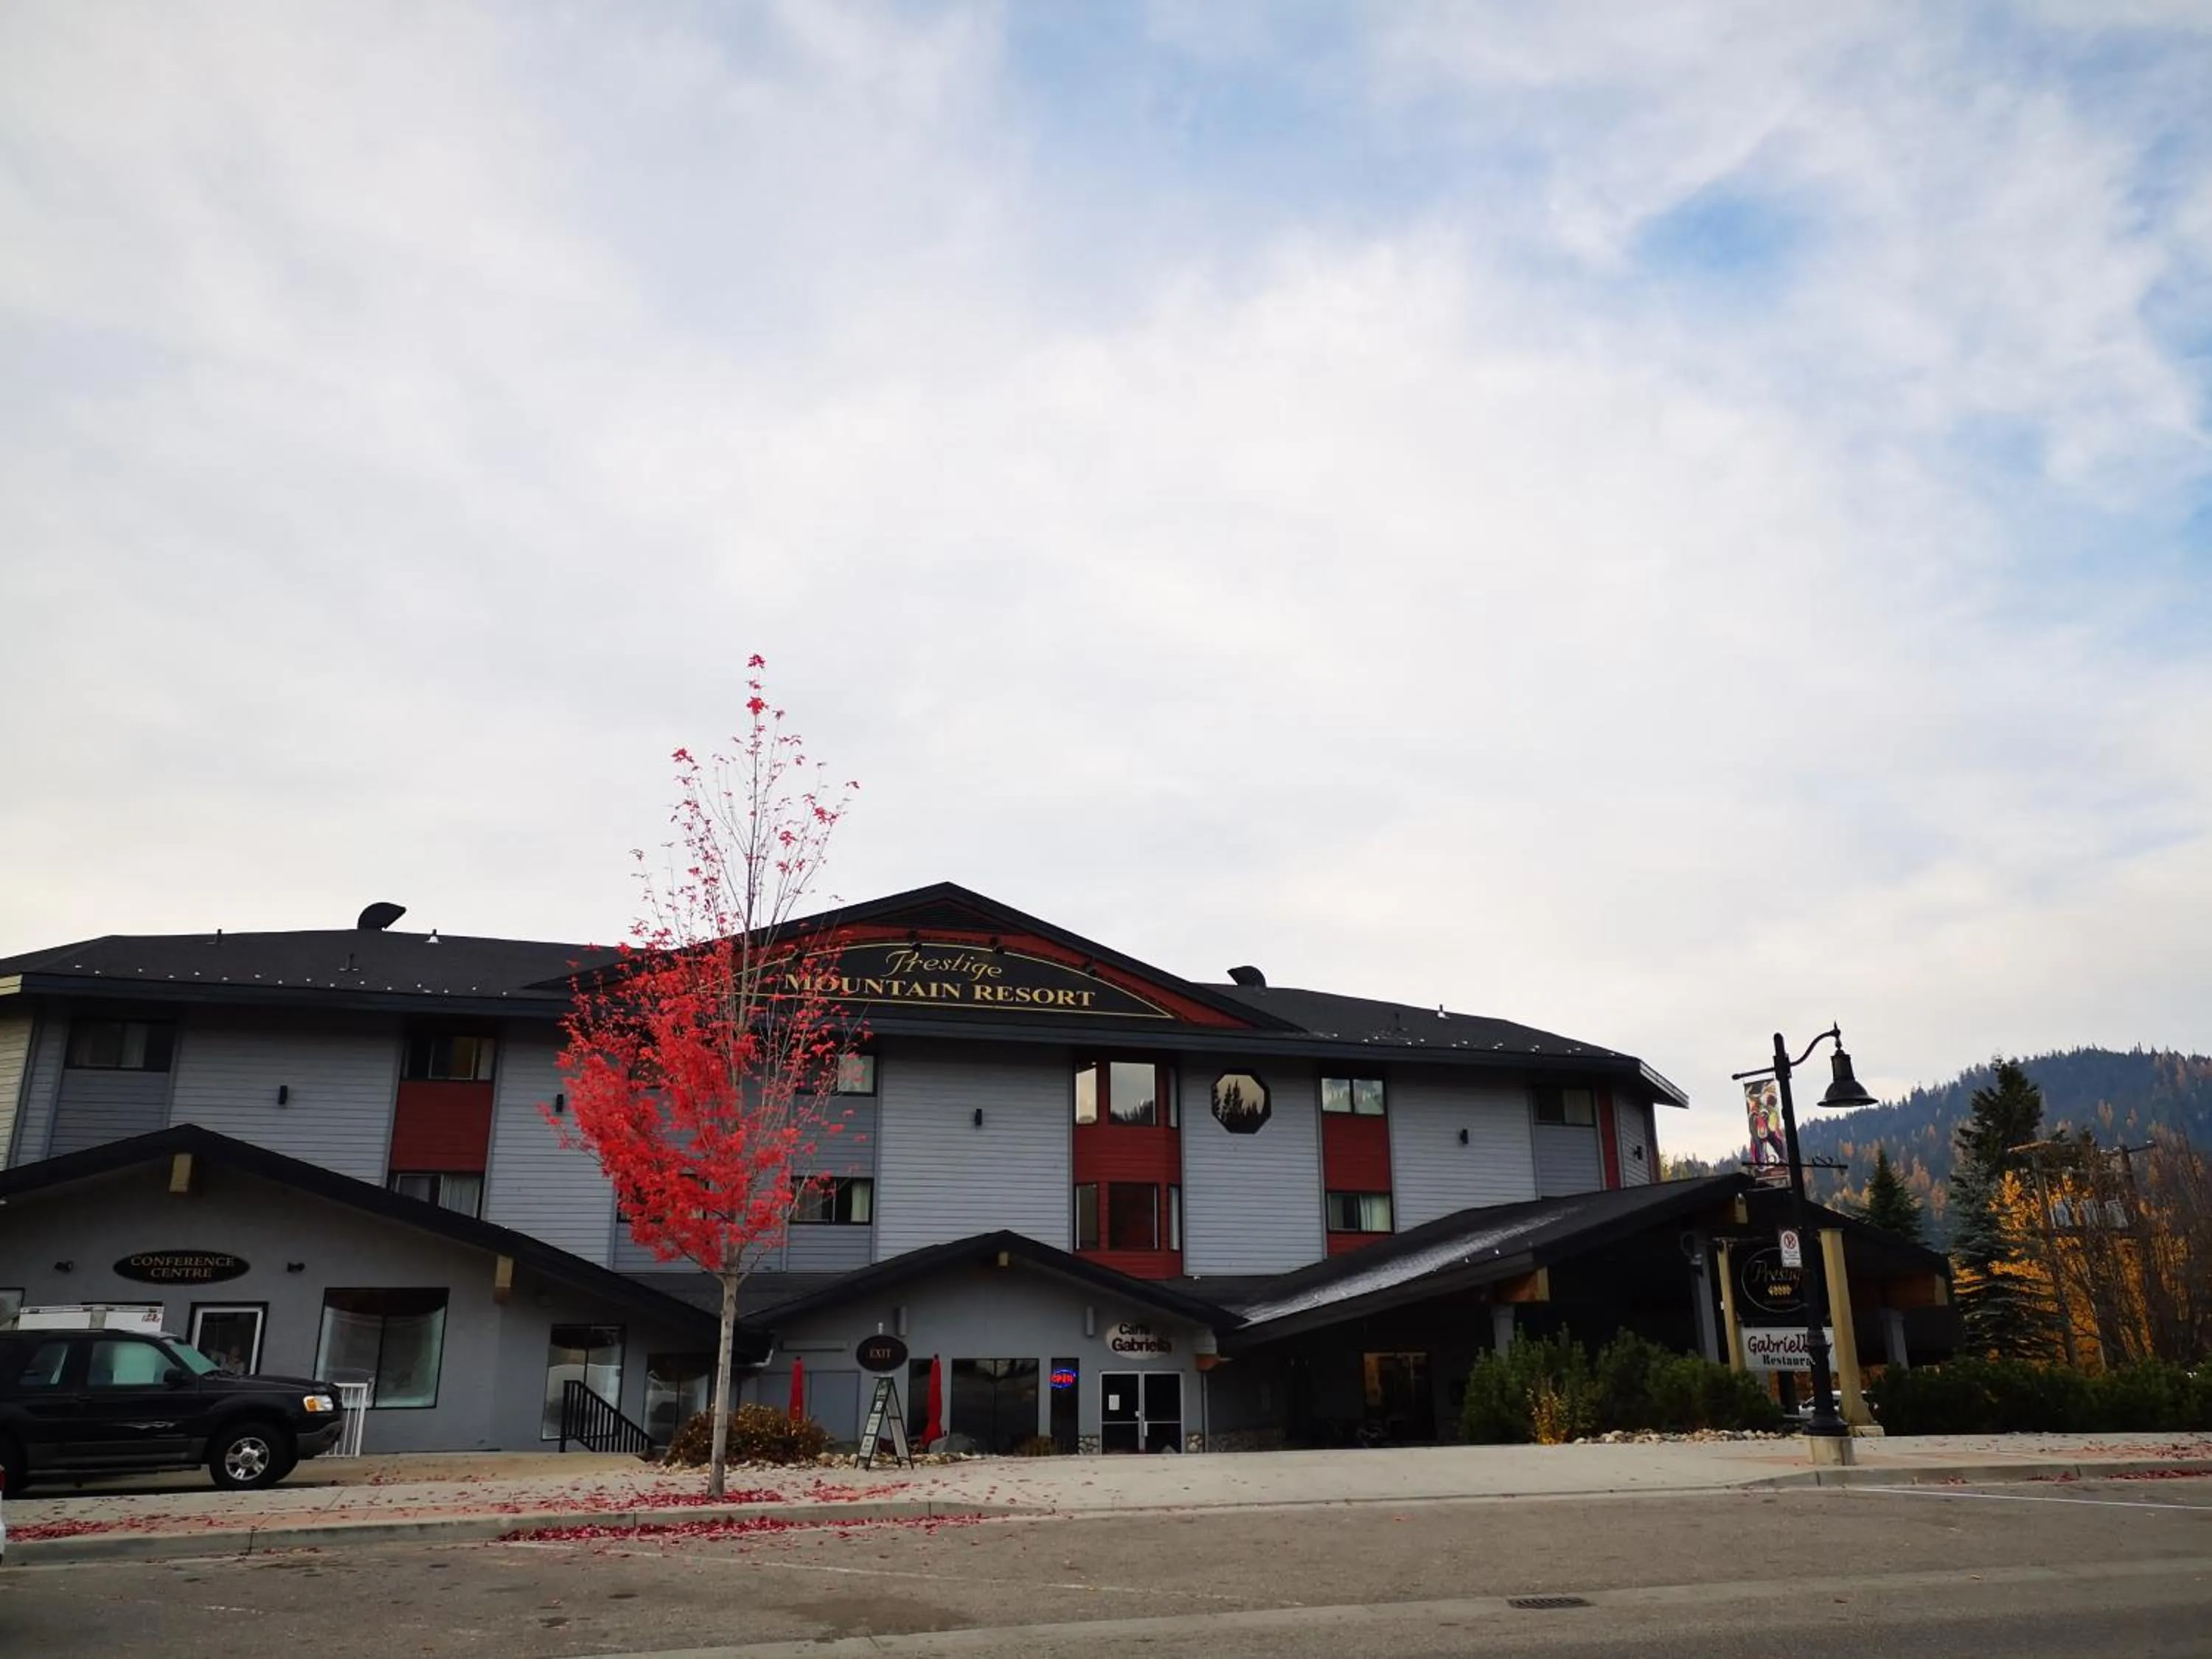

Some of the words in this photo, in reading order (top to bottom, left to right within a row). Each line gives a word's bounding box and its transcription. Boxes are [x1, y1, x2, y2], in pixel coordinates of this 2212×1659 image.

[880, 950, 1003, 981] Prestige
[785, 973, 961, 999] MOUNTAIN
[973, 984, 1096, 1006] RESORT
[130, 1256, 236, 1267] CONFERENCE
[150, 1267, 213, 1279] CENTRE
[1752, 1259, 1801, 1289] Prestig
[1747, 1333, 1809, 1354] Gabriell
[868, 1348, 892, 1359] EXIT
[1763, 1354, 1812, 1366] Restaura
